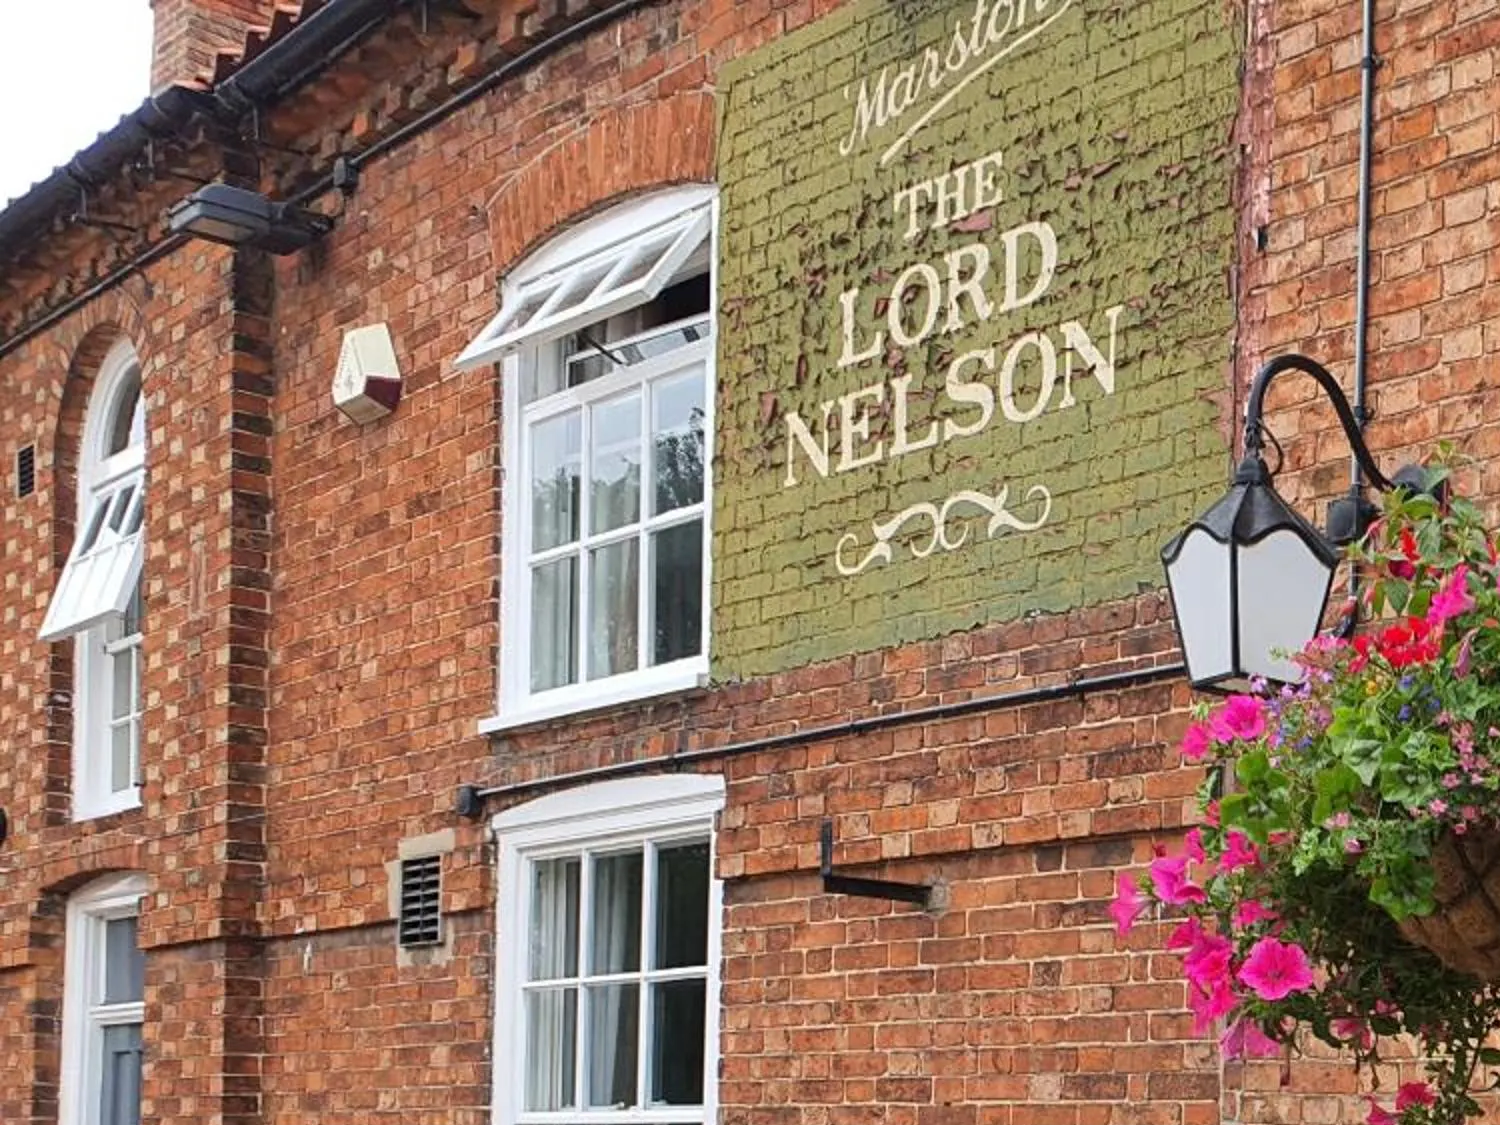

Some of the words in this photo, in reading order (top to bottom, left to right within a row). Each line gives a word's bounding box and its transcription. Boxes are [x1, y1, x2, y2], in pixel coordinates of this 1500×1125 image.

[893, 152, 1003, 240] THE
[836, 221, 1060, 368] LORD
[782, 305, 1125, 488] NELSON
